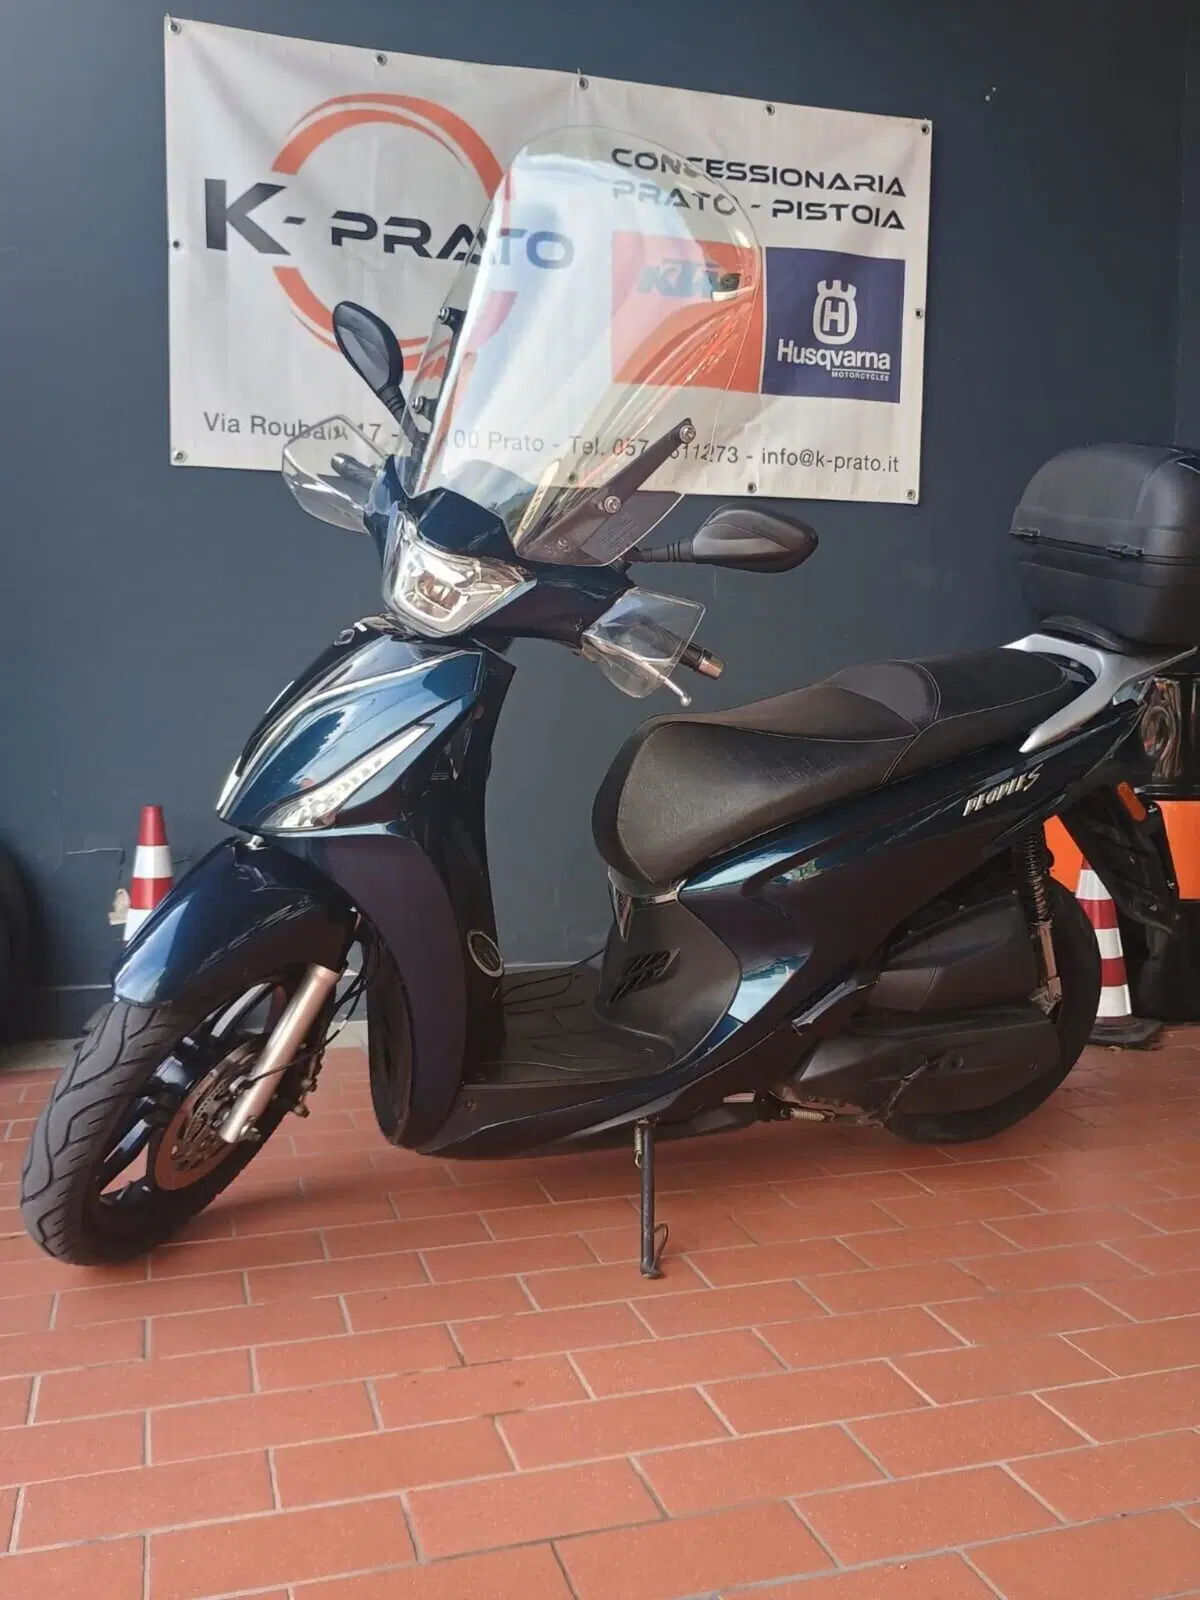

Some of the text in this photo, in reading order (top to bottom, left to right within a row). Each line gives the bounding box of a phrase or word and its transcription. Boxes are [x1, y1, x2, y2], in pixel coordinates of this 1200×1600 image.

[611, 147, 907, 198] CONCESSIONARIA
[612, 179, 738, 216] PRATO
[771, 198, 906, 231] PISTOIA
[331, 209, 575, 270] PRATO
[777, 338, 892, 371] Husqvarna
[831, 370, 890, 382] MOTORCYCLES
[203, 411, 241, 434] Via
[487, 431, 545, 453] Prato
[569, 435, 605, 457] Tel.
[761, 447, 900, 474] info@k-prato.it
